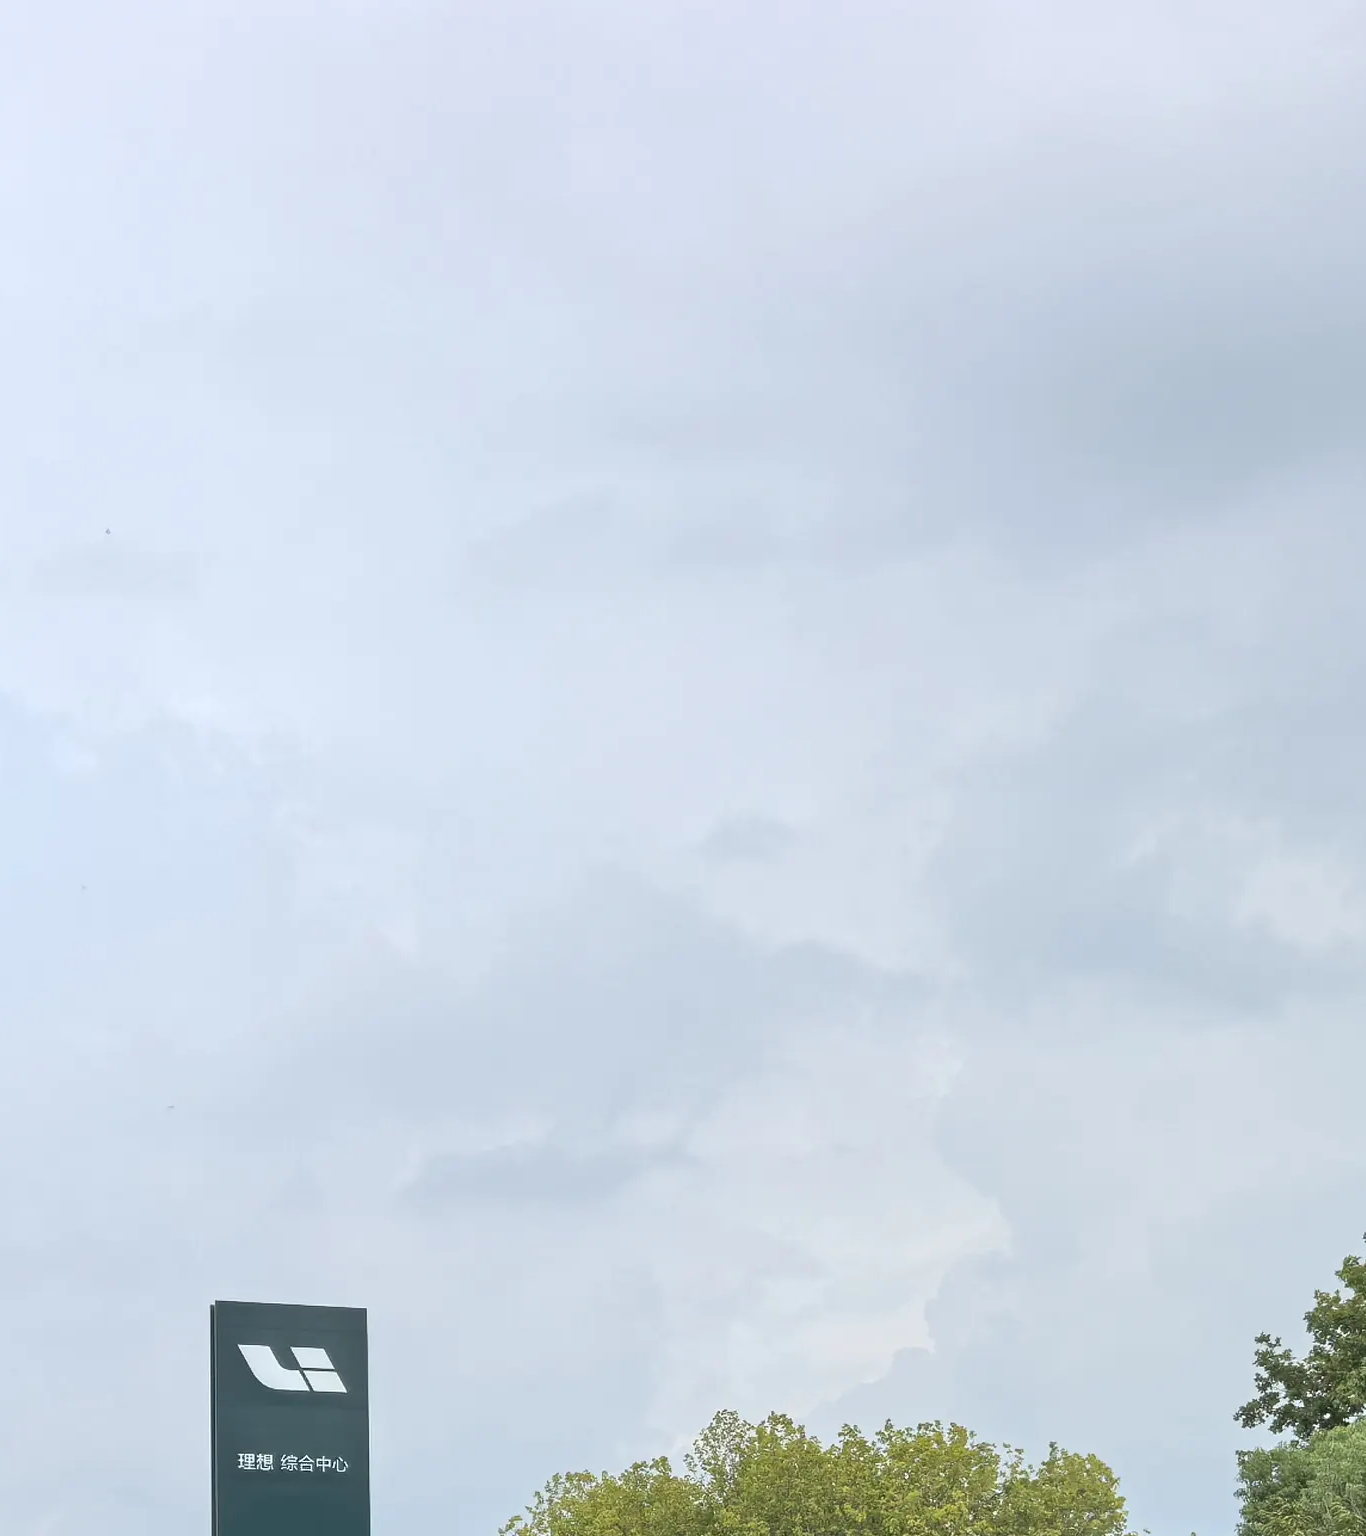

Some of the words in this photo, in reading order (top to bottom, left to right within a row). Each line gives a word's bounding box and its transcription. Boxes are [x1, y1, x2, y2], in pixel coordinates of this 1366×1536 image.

[237, 1453, 274, 1471] 理想
[280, 1454, 349, 1472] 综合中心
